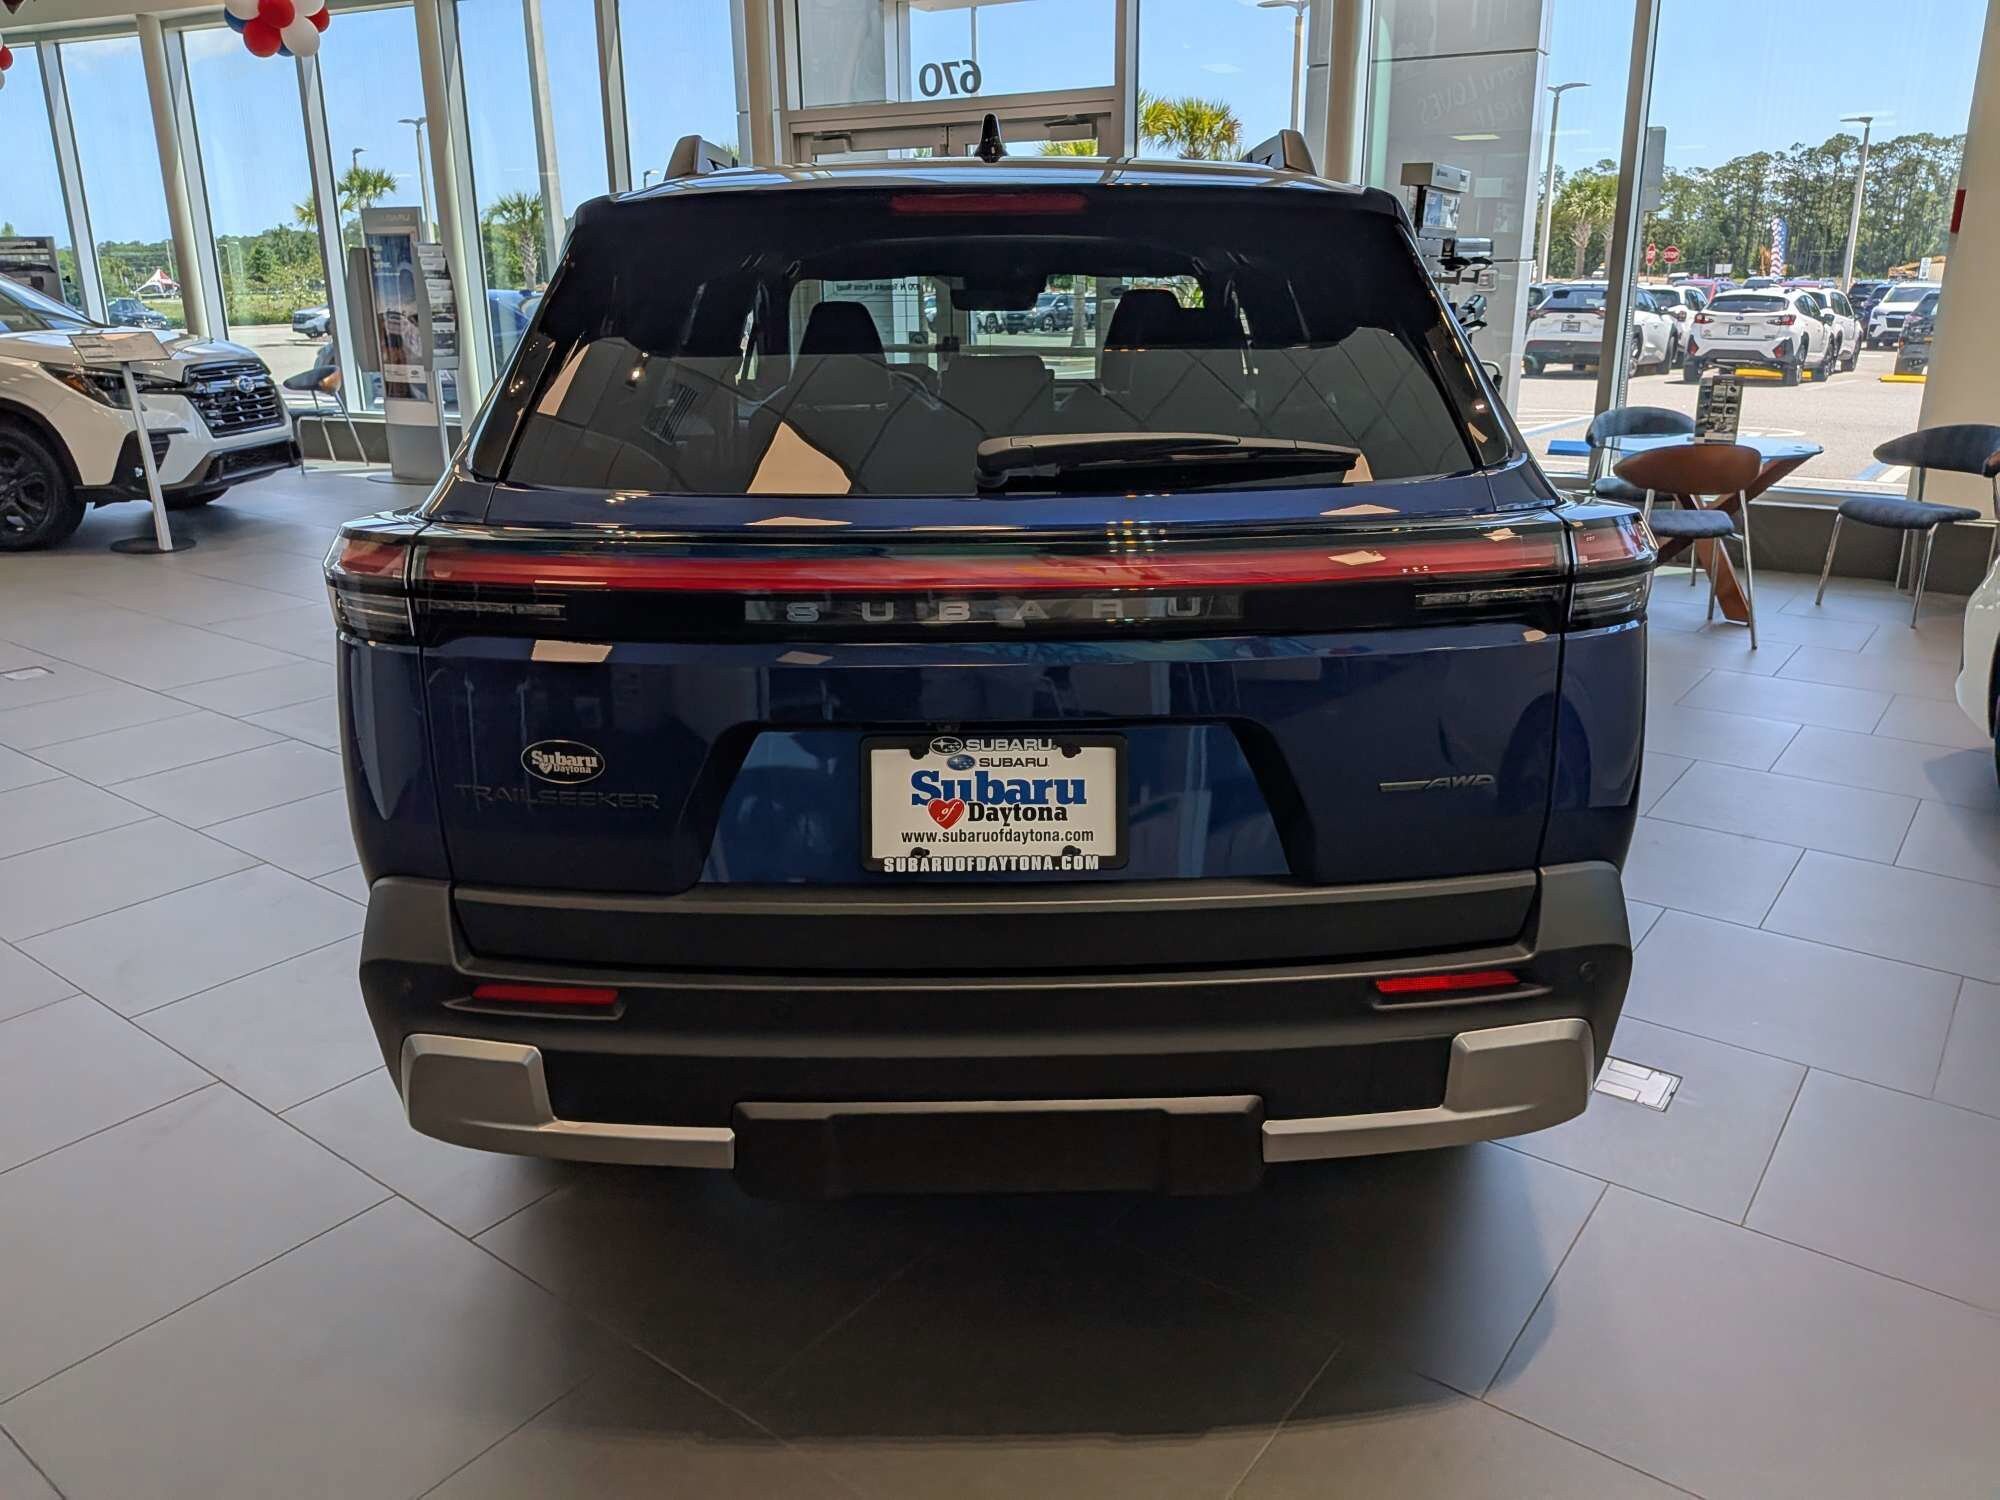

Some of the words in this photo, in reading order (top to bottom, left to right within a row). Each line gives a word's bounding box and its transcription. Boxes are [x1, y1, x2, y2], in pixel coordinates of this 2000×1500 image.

[785, 595, 1202, 624] SUBARU
[966, 738, 1053, 752] SUBARU
[531, 750, 598, 767] Subaru
[978, 757, 1049, 768] SUBARU
[553, 765, 592, 775] Daytona
[911, 770, 1087, 806] Subaru
[1425, 773, 1496, 790] AWD
[453, 783, 660, 810] TRAILSEEKER
[936, 801, 960, 822] of
[967, 802, 1068, 826] Daytona
[901, 828, 1094, 843] www.subaruofdaytona.com
[884, 855, 1099, 873] SUBARUOFDAYTONA.COM
